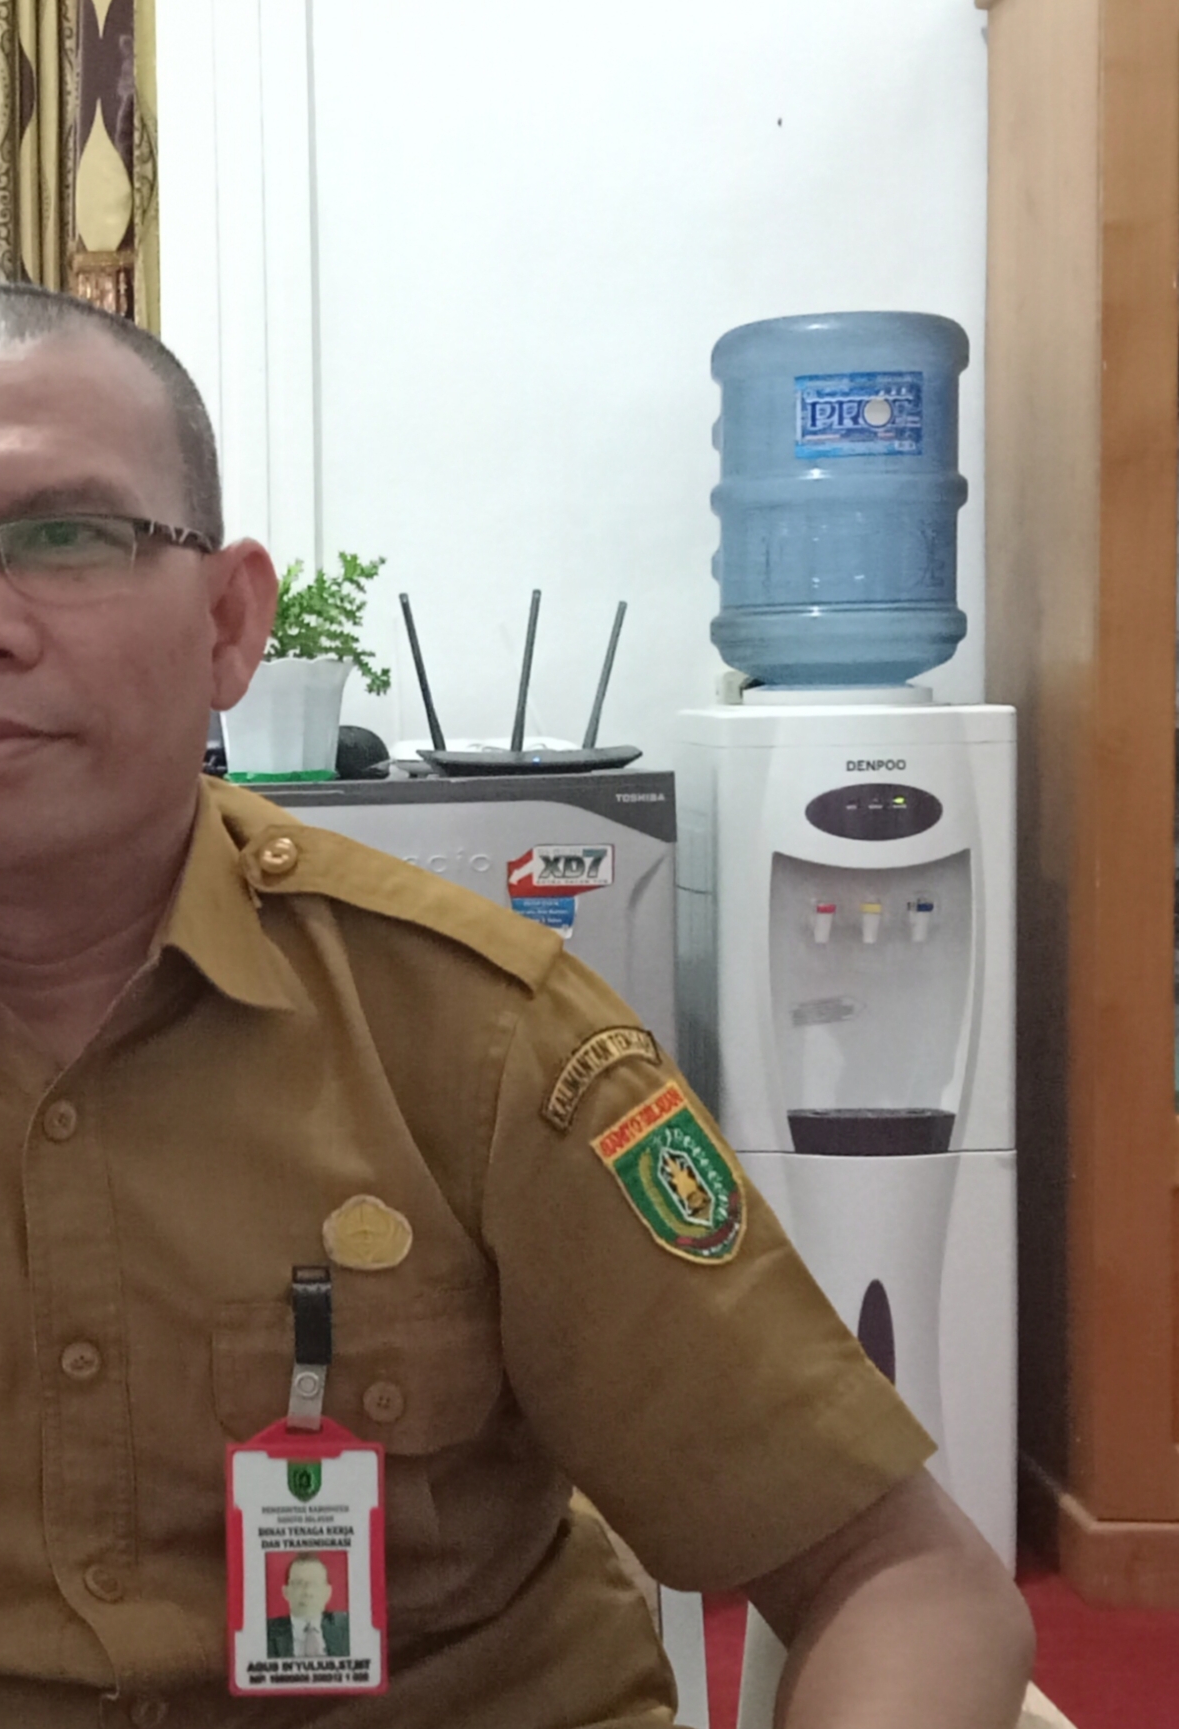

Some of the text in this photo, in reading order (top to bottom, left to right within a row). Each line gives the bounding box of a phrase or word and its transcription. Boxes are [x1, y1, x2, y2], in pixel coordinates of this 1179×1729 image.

[846, 759, 907, 771] DENPOO
[616, 793, 666, 802] TOSHIBA
[538, 848, 608, 879] XD7
[550, 1033, 612, 1121] KALIMANTAN
[288, 1527, 324, 1536] TENAGA
[326, 1526, 355, 1536] KERJA
